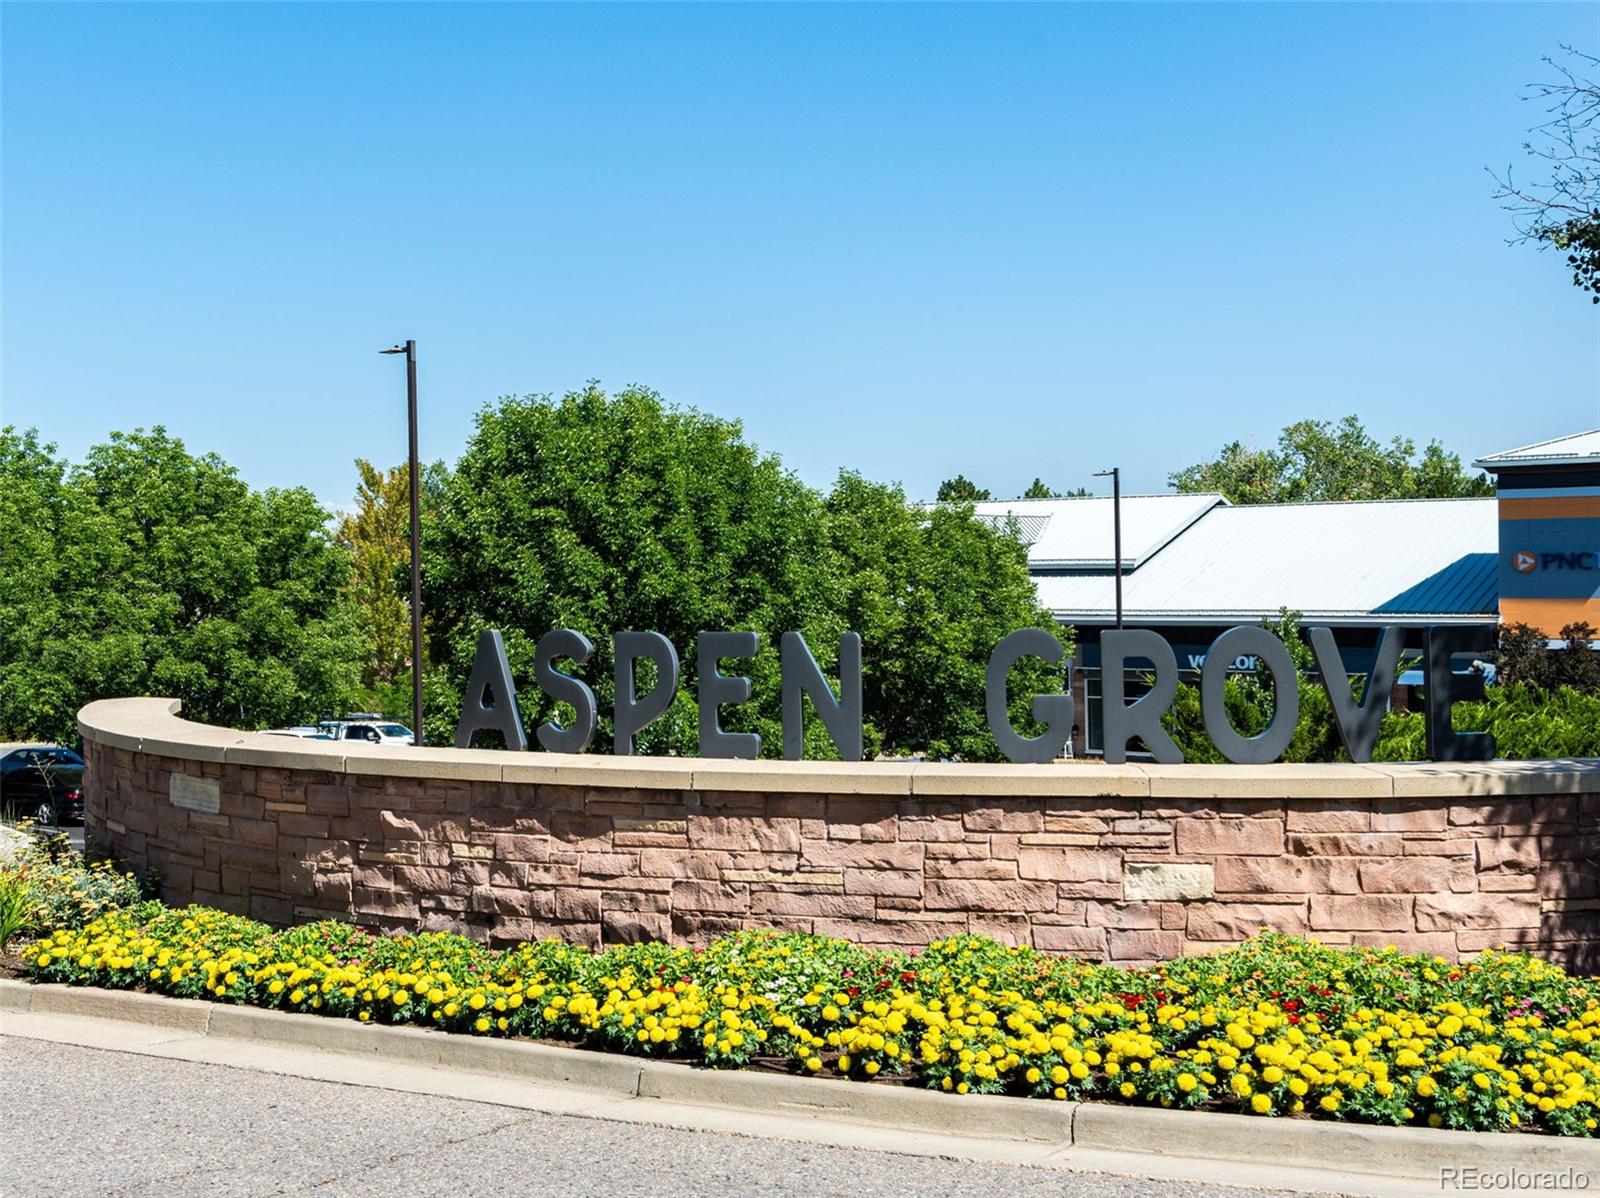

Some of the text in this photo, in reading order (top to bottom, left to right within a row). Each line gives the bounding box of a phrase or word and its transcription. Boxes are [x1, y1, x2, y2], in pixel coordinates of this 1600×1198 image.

[1540, 552, 1593, 570] PNC
[455, 625, 1497, 764] ASPEN GROVE
